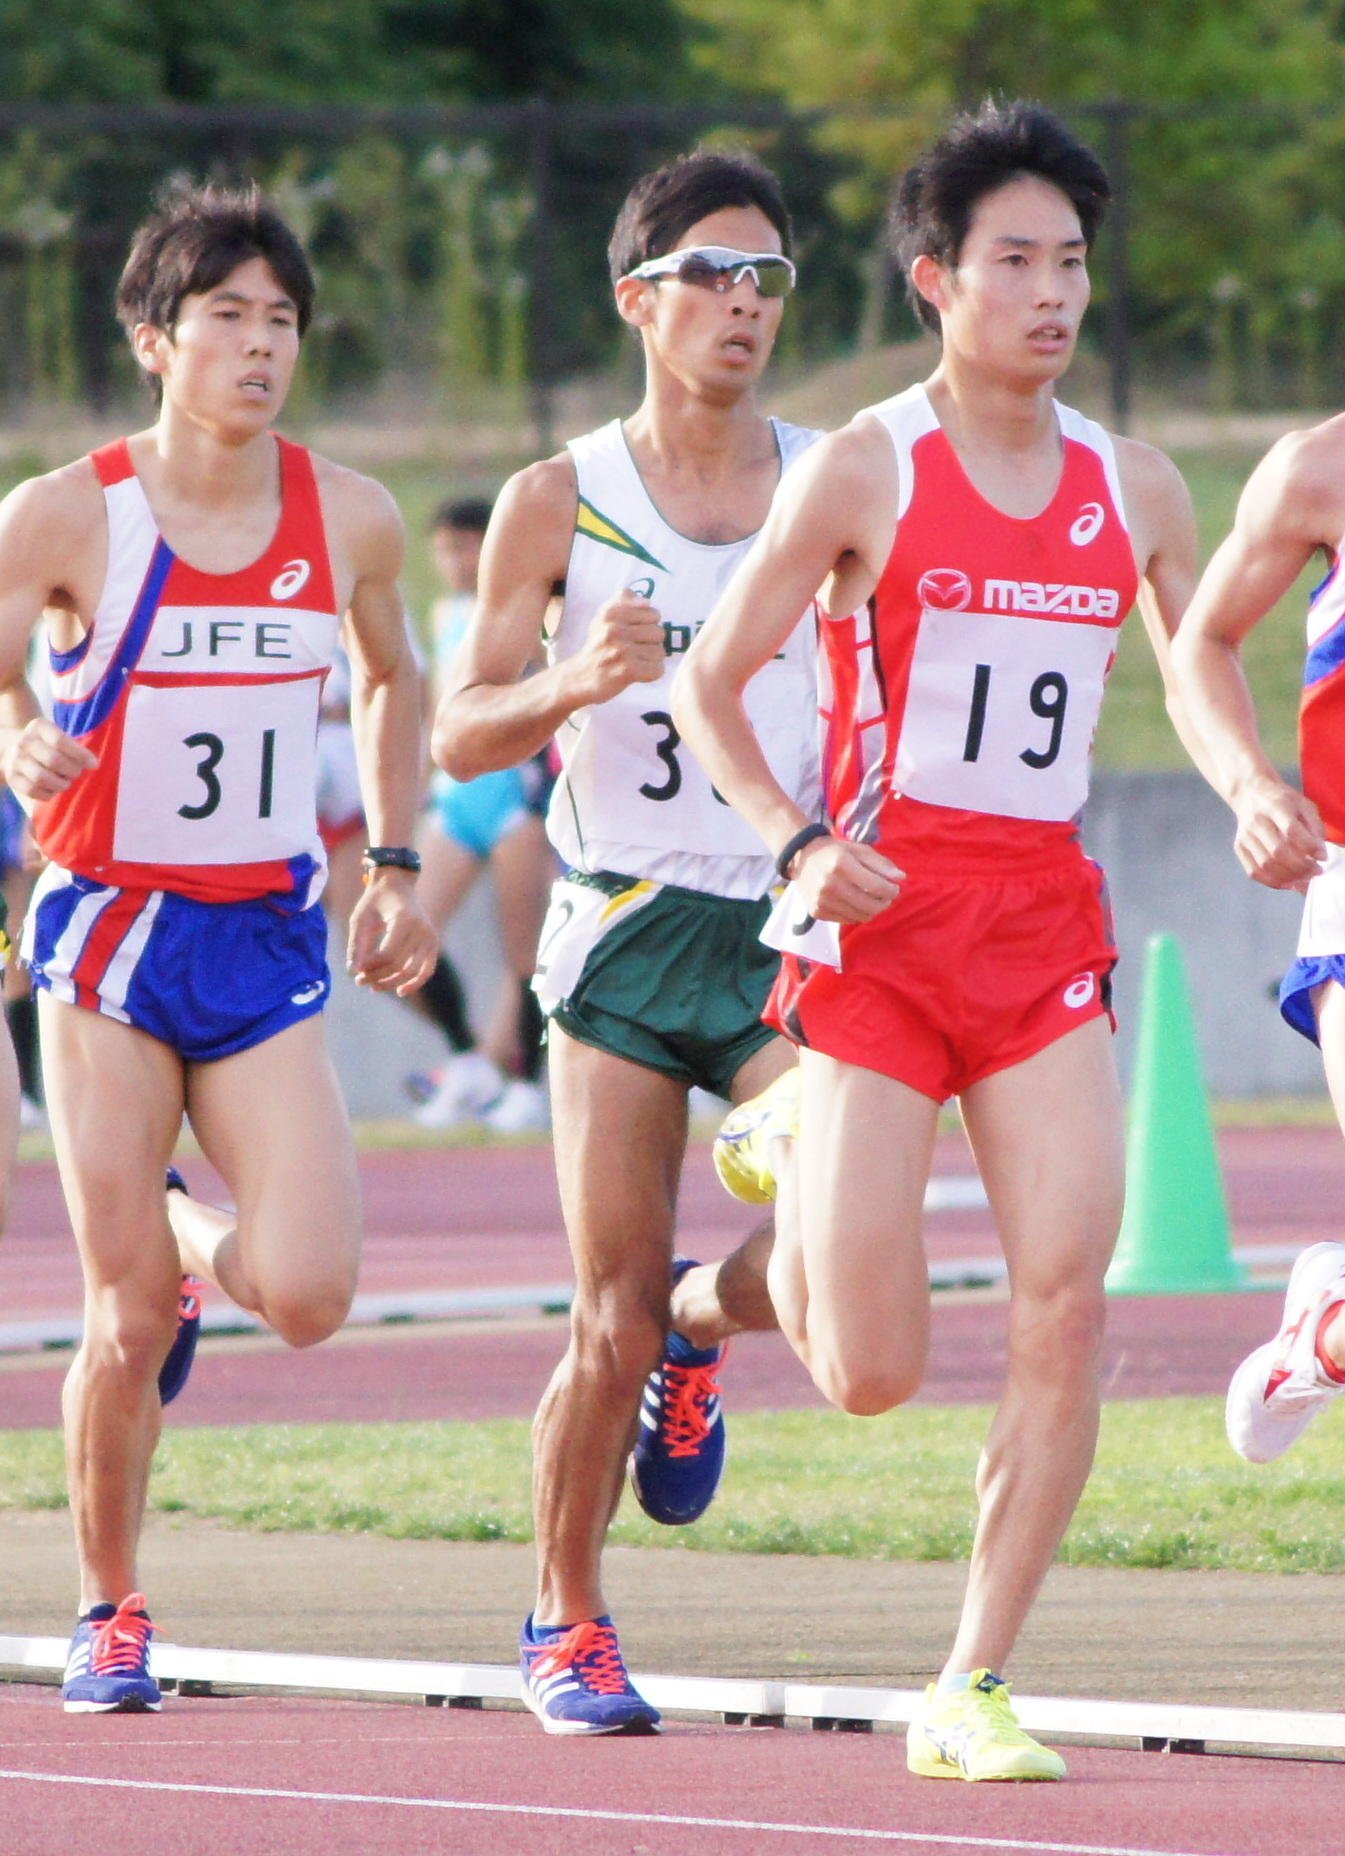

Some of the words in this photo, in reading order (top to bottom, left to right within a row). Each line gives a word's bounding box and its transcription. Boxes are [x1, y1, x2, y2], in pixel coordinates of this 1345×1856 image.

[160, 621, 292, 659] JFE
[638, 710, 732, 807] 3
[962, 663, 1069, 770] 19
[176, 728, 276, 820] 31
